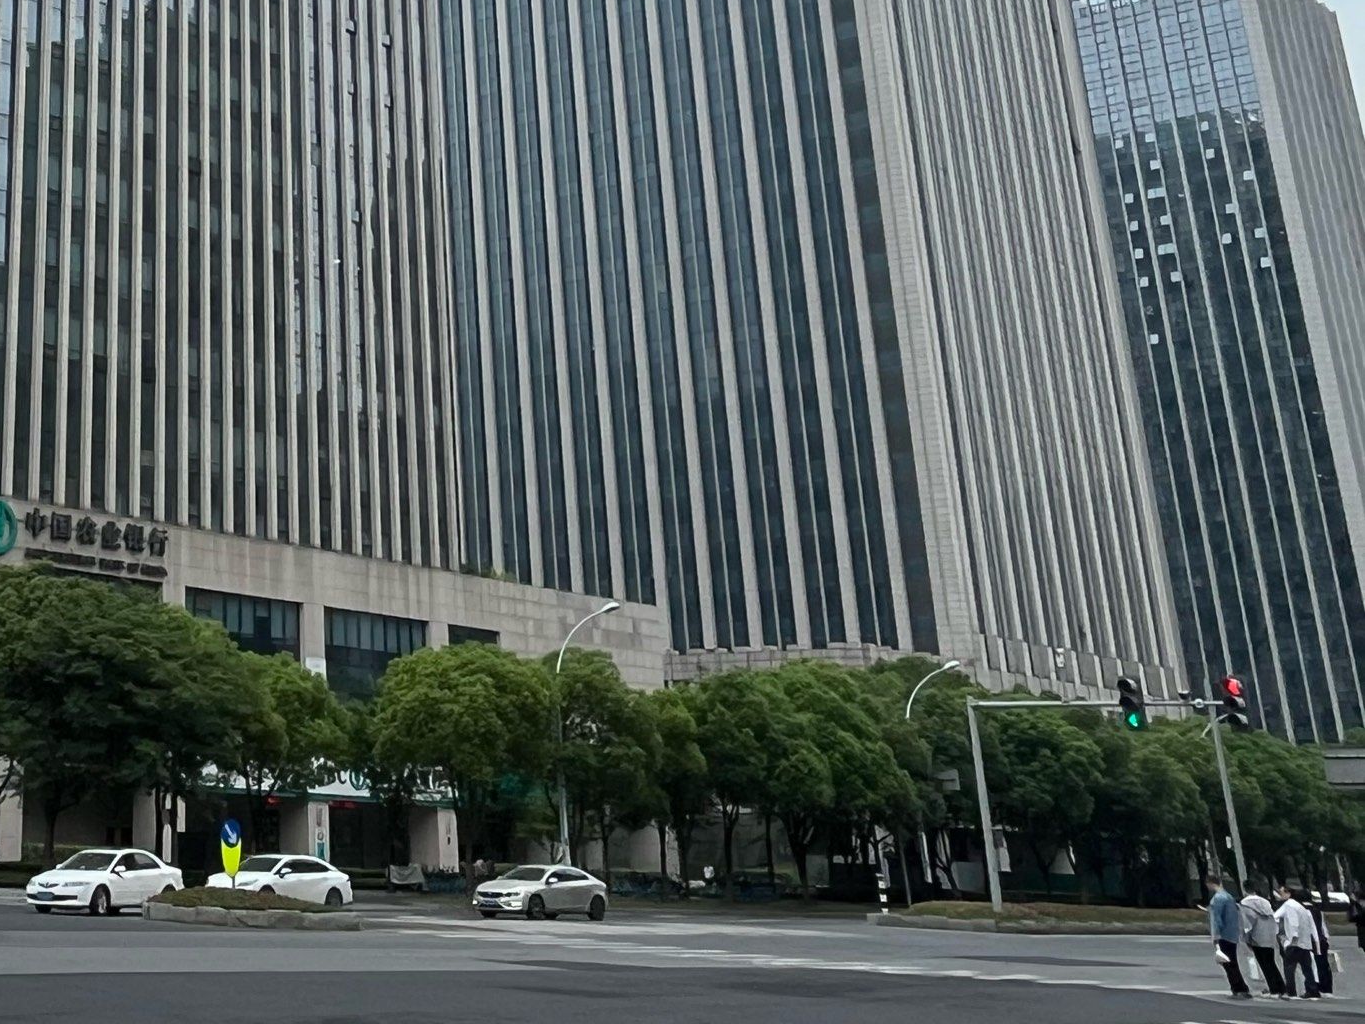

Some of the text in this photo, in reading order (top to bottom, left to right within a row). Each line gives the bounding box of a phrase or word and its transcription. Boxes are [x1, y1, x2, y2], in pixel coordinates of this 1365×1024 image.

[25, 508, 168, 557] 中国农业银行
